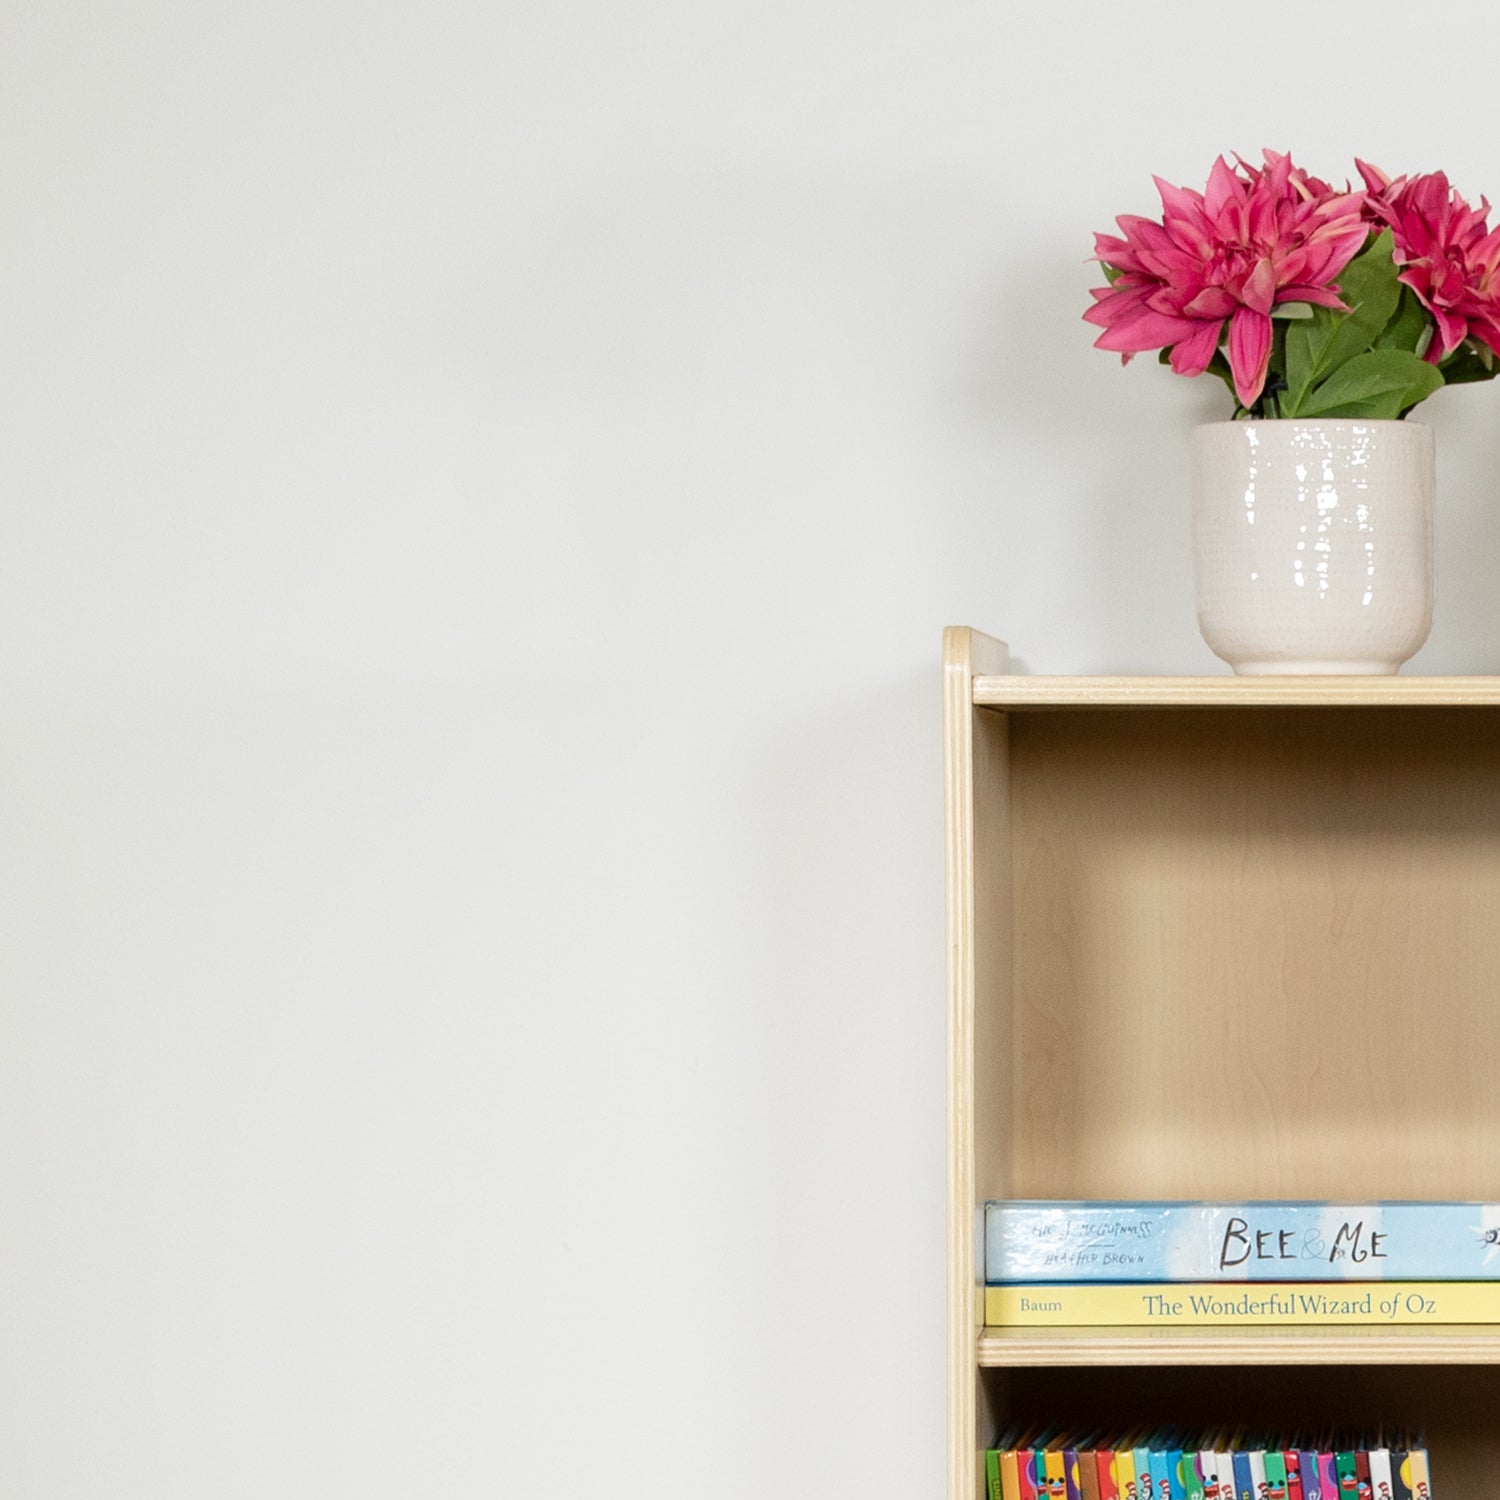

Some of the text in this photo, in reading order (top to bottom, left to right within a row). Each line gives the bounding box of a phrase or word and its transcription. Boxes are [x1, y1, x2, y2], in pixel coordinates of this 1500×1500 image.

[1220, 1218, 1387, 1271] BEE & ME
[1103, 1253, 1144, 1264] BROWN
[1021, 1299, 1062, 1311] Baum
[1143, 1293, 1437, 1318] The Wonderful Wizard of Oz
